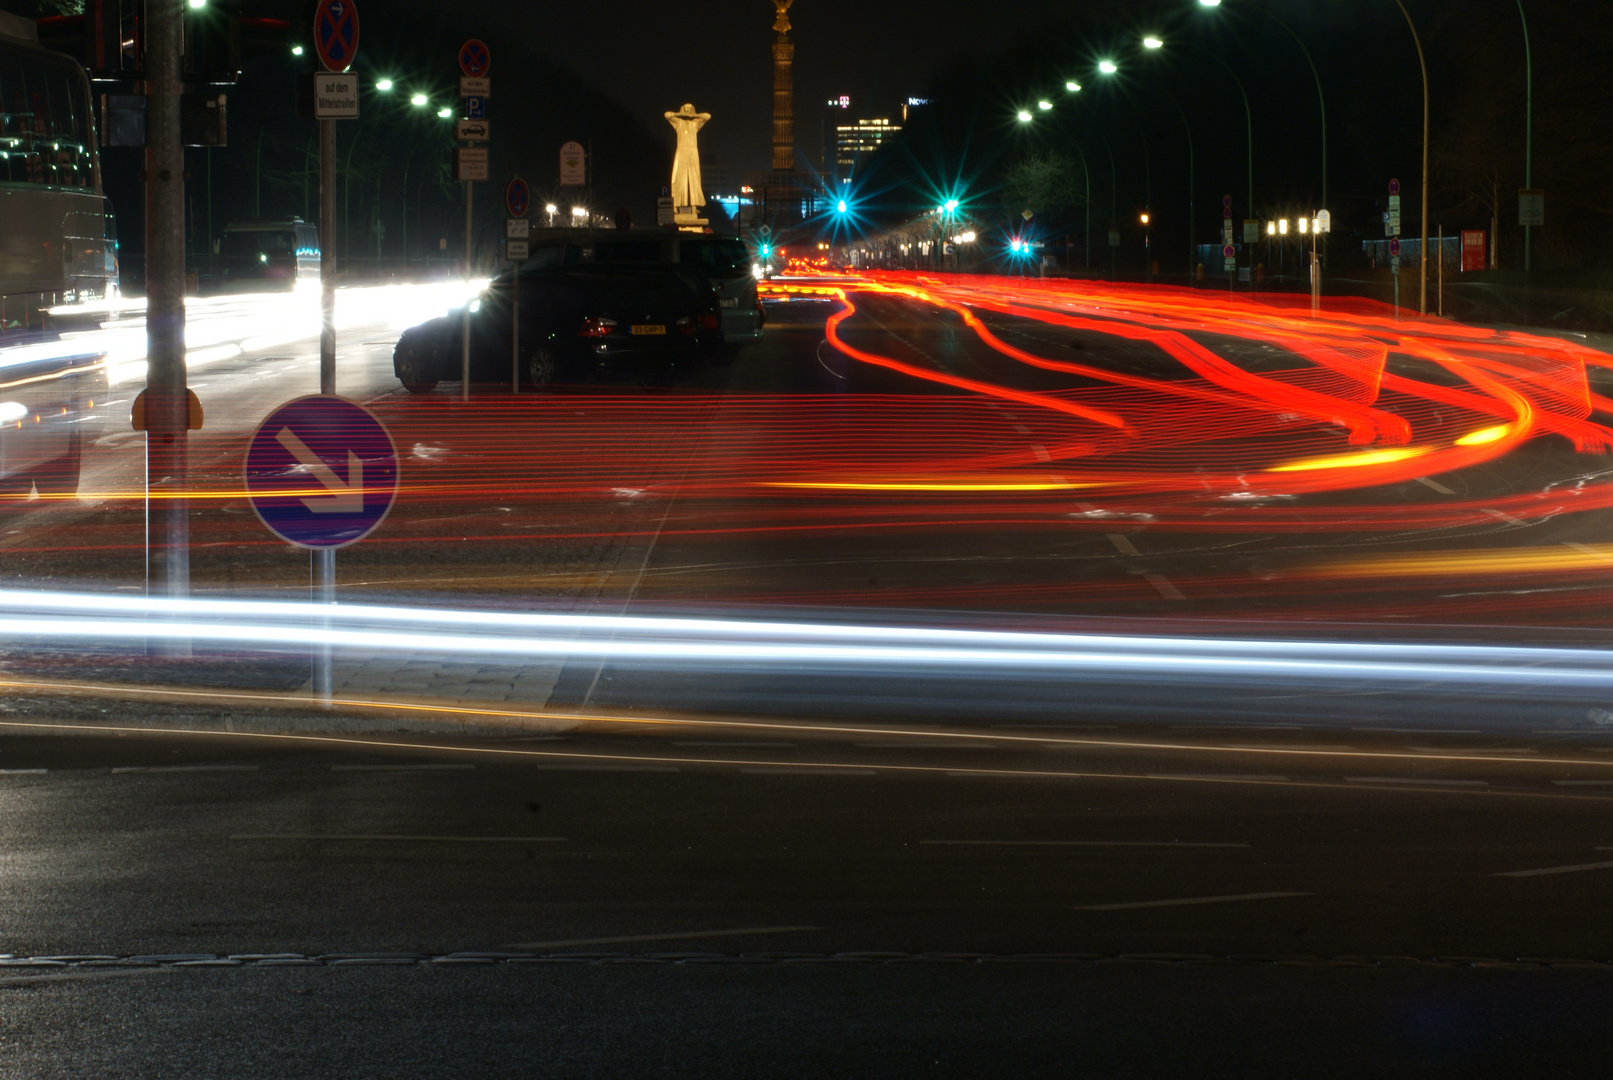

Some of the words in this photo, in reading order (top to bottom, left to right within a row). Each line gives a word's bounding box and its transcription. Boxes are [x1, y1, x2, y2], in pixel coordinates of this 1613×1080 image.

[326, 82, 335, 93] auf
[336, 82, 348, 93] dem
[319, 98, 356, 109] Mittelstreifen
